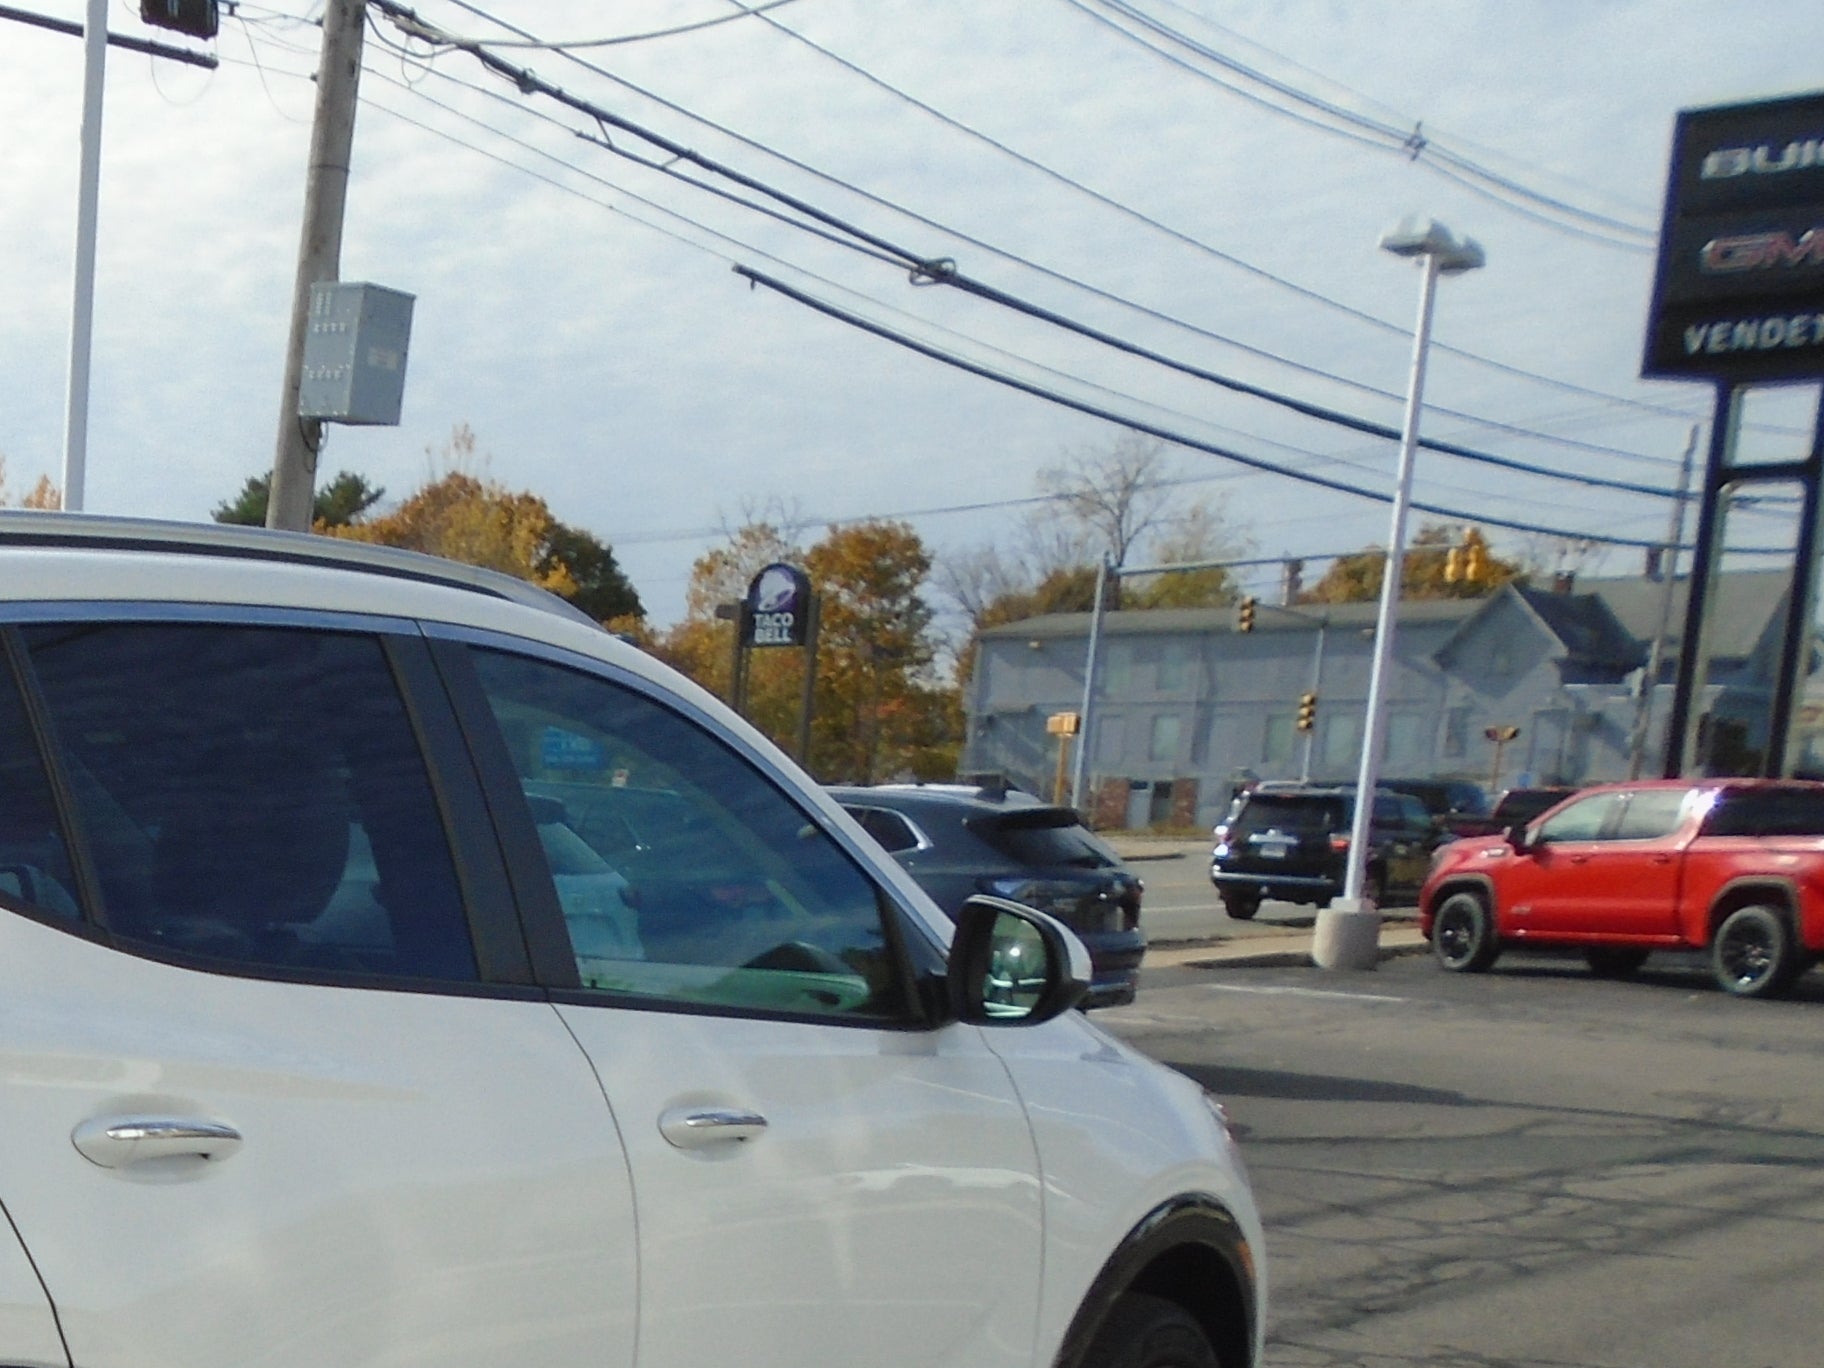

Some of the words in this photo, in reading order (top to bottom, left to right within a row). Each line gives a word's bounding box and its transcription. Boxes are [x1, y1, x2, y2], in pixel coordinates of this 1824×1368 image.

[1701, 140, 1824, 180] BUI
[752, 613, 794, 628] TACO
[754, 628, 792, 644] BELL
